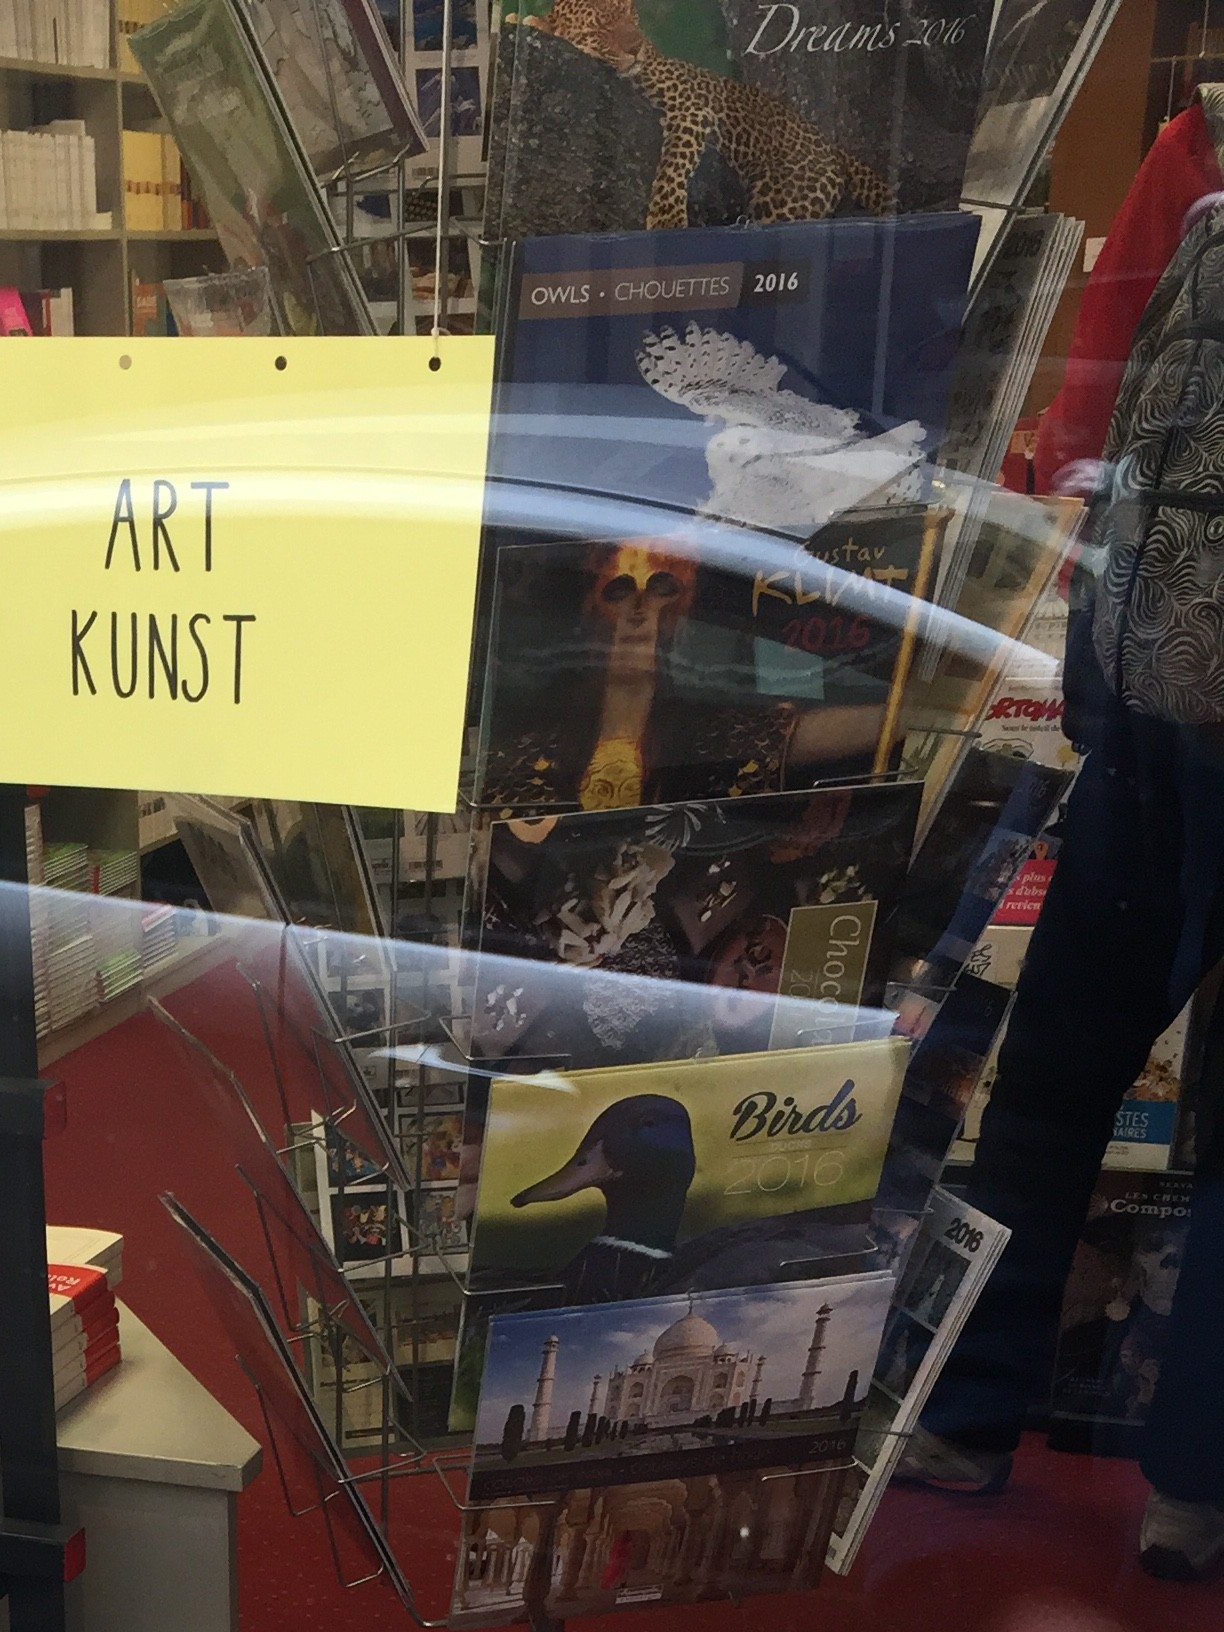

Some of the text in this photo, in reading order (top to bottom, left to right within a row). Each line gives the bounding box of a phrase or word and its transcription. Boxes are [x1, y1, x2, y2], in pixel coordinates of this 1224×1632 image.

[741, 3, 976, 56] Dreams 2016
[531, 272, 799, 305] OWLS CHOUETTES 2016
[106, 480, 229, 572] ART
[71, 610, 256, 703] KUNST
[730, 1079, 863, 1141] Birds
[724, 1151, 845, 1195] 2016
[944, 1218, 984, 1252] 2016
[808, 1438, 846, 1455] 2016
